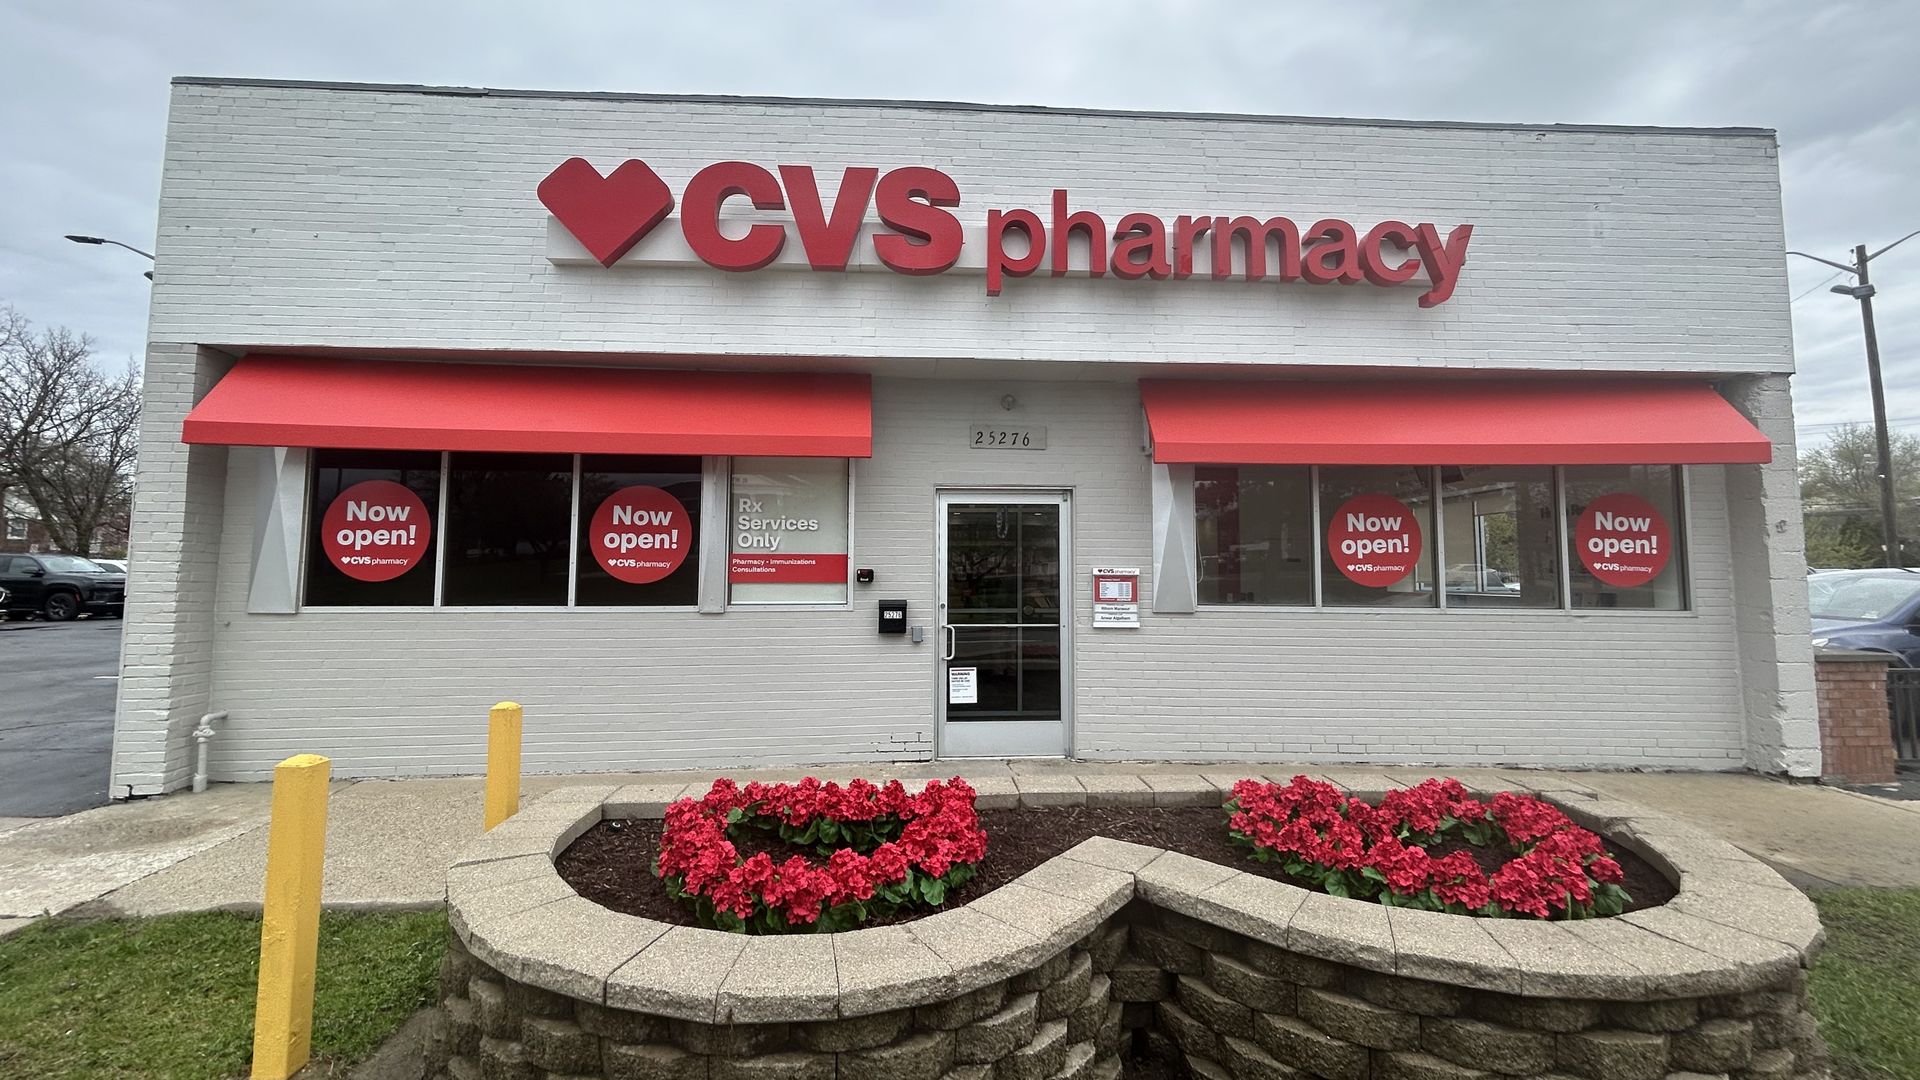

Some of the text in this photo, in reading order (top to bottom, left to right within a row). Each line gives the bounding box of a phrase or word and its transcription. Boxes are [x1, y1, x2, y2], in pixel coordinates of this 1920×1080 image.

[680, 160, 1475, 308] CVS pharmacy
[975, 431, 1030, 447] 25276
[346, 500, 411, 522] Now
[739, 498, 763, 513] Rx
[612, 505, 673, 526] Now
[738, 515, 819, 531] Services
[1346, 513, 1402, 532] Now
[1595, 511, 1651, 532] Now
[336, 524, 417, 551] open!
[603, 529, 679, 554] open!
[737, 532, 781, 551] Only
[1341, 534, 1410, 559] open!
[1588, 535, 1658, 558] open!
[350, 556, 409, 566] CVS pharmacy
[616, 559, 672, 569] CVS pharmacy
[732, 558, 765, 567] Pharmacy
[1355, 564, 1406, 572] CVS pharmacy
[1601, 563, 1653, 574] CVS pharmacy
